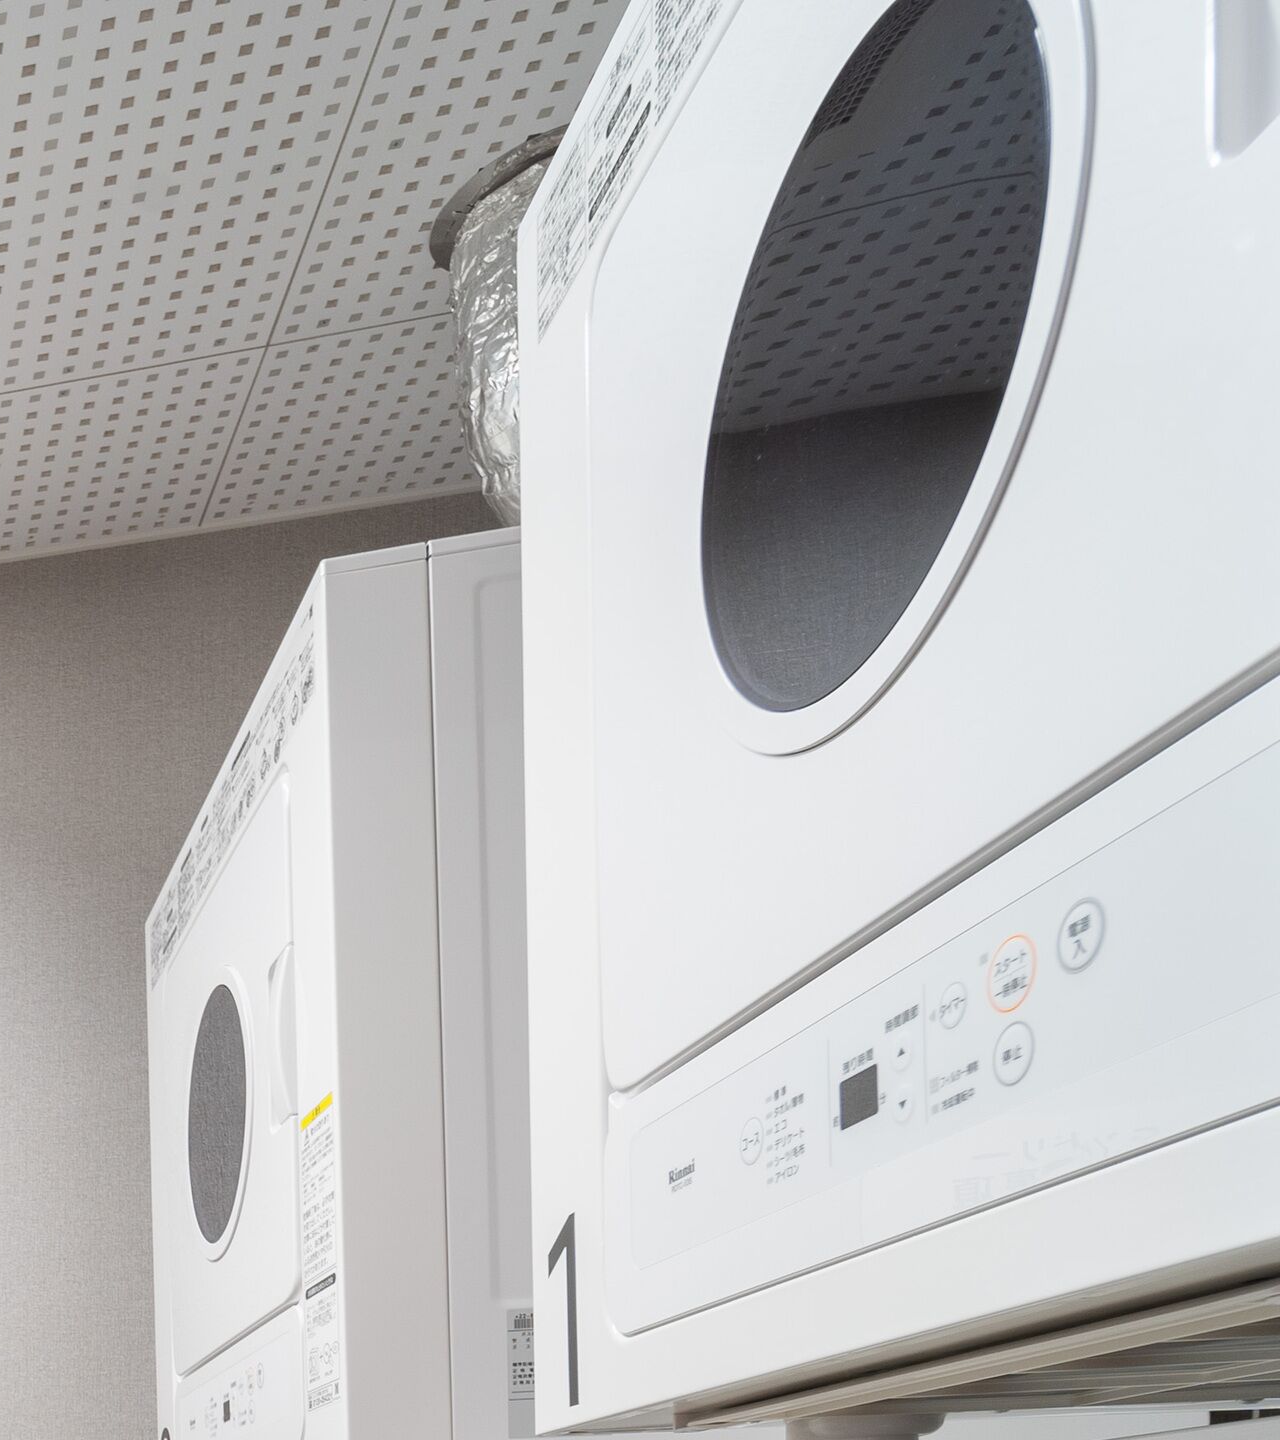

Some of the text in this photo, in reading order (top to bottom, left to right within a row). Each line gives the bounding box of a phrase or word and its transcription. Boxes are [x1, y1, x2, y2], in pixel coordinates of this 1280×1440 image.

[1067, 915, 1091, 939] 電源
[1071, 937, 1089, 959] 入
[993, 948, 1028, 979] スタート
[841, 1048, 875, 1074] 残り時間
[1000, 1043, 1024, 1066] 停止
[739, 1130, 763, 1153] コース
[773, 1127, 806, 1153] デリケート
[667, 1157, 697, 1187] Rinnai
[773, 1164, 801, 1184] アイロン
[547, 1212, 580, 1408] 1
